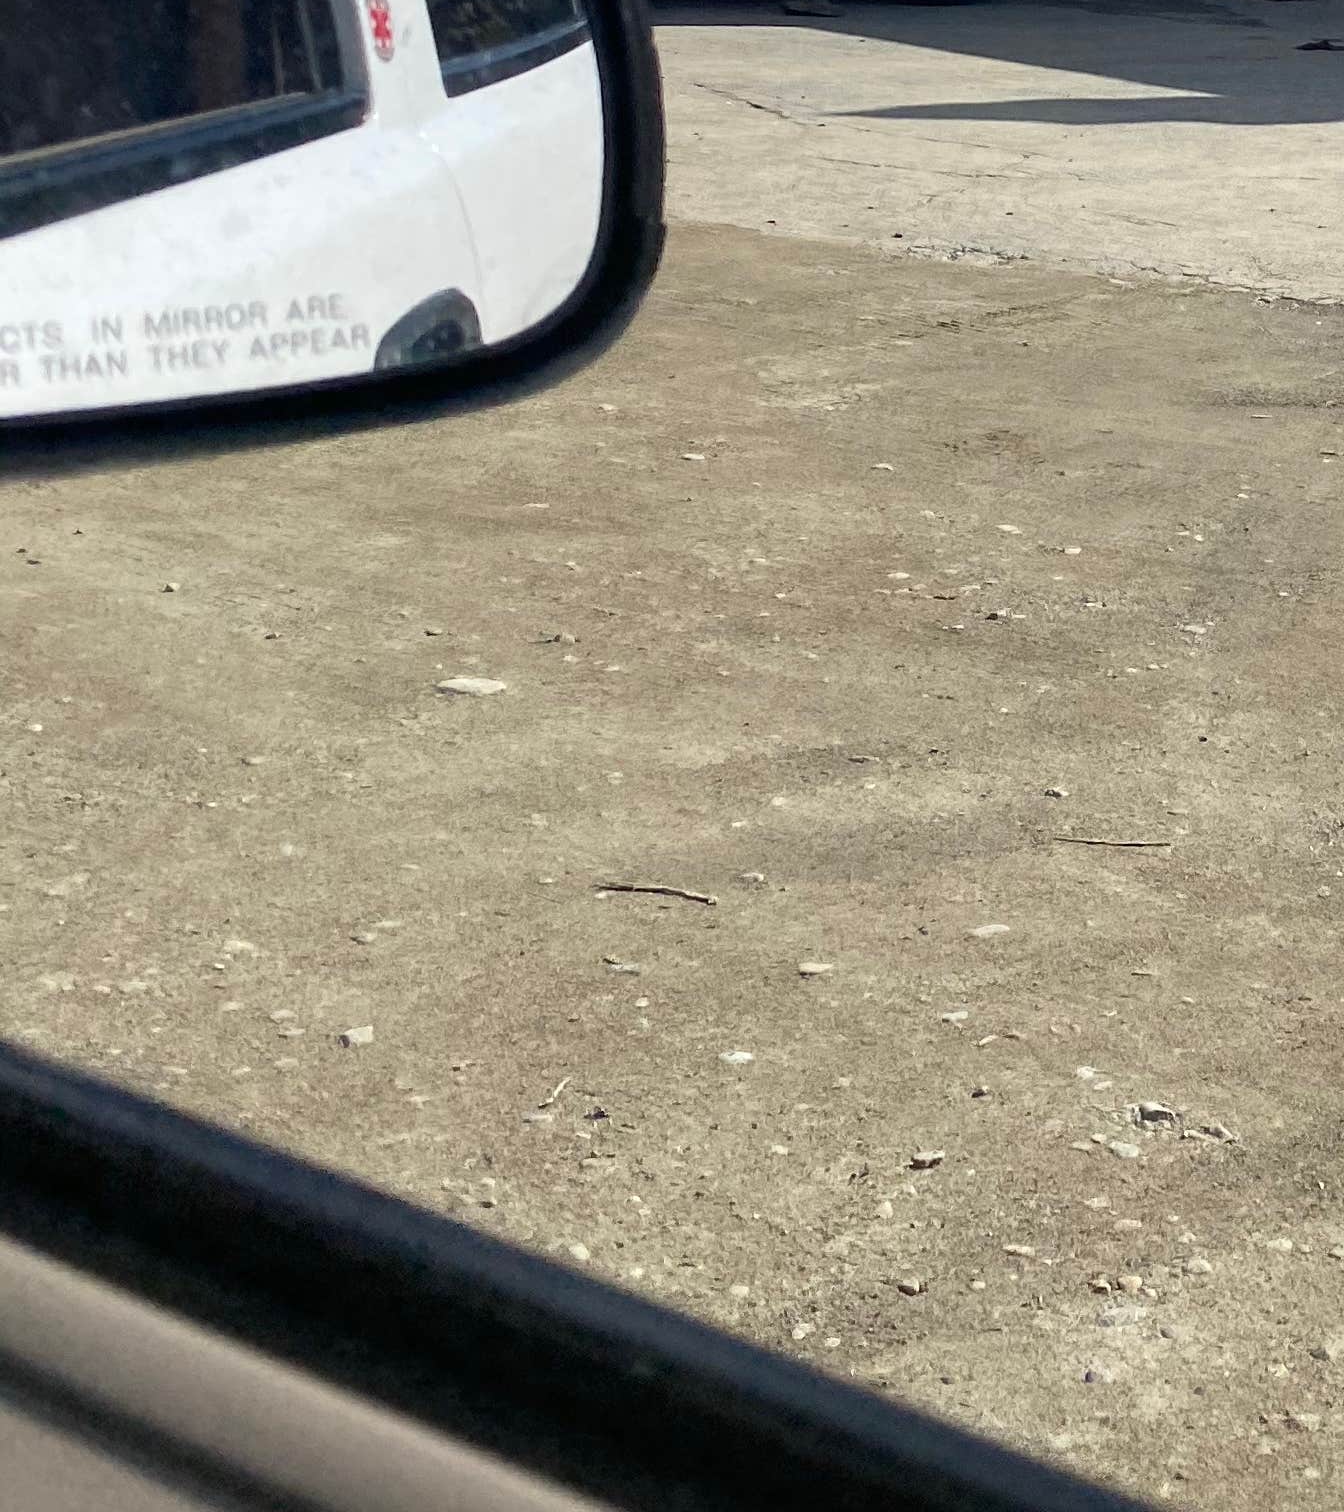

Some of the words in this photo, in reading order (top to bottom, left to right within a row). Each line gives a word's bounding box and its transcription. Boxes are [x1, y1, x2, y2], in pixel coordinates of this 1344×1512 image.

[91, 314, 124, 344] IN
[143, 300, 269, 338] MIRROR
[285, 292, 348, 322] ARE
[38, 348, 129, 382] THAN
[146, 339, 231, 370] THEY
[250, 322, 372, 362] APPEAR
